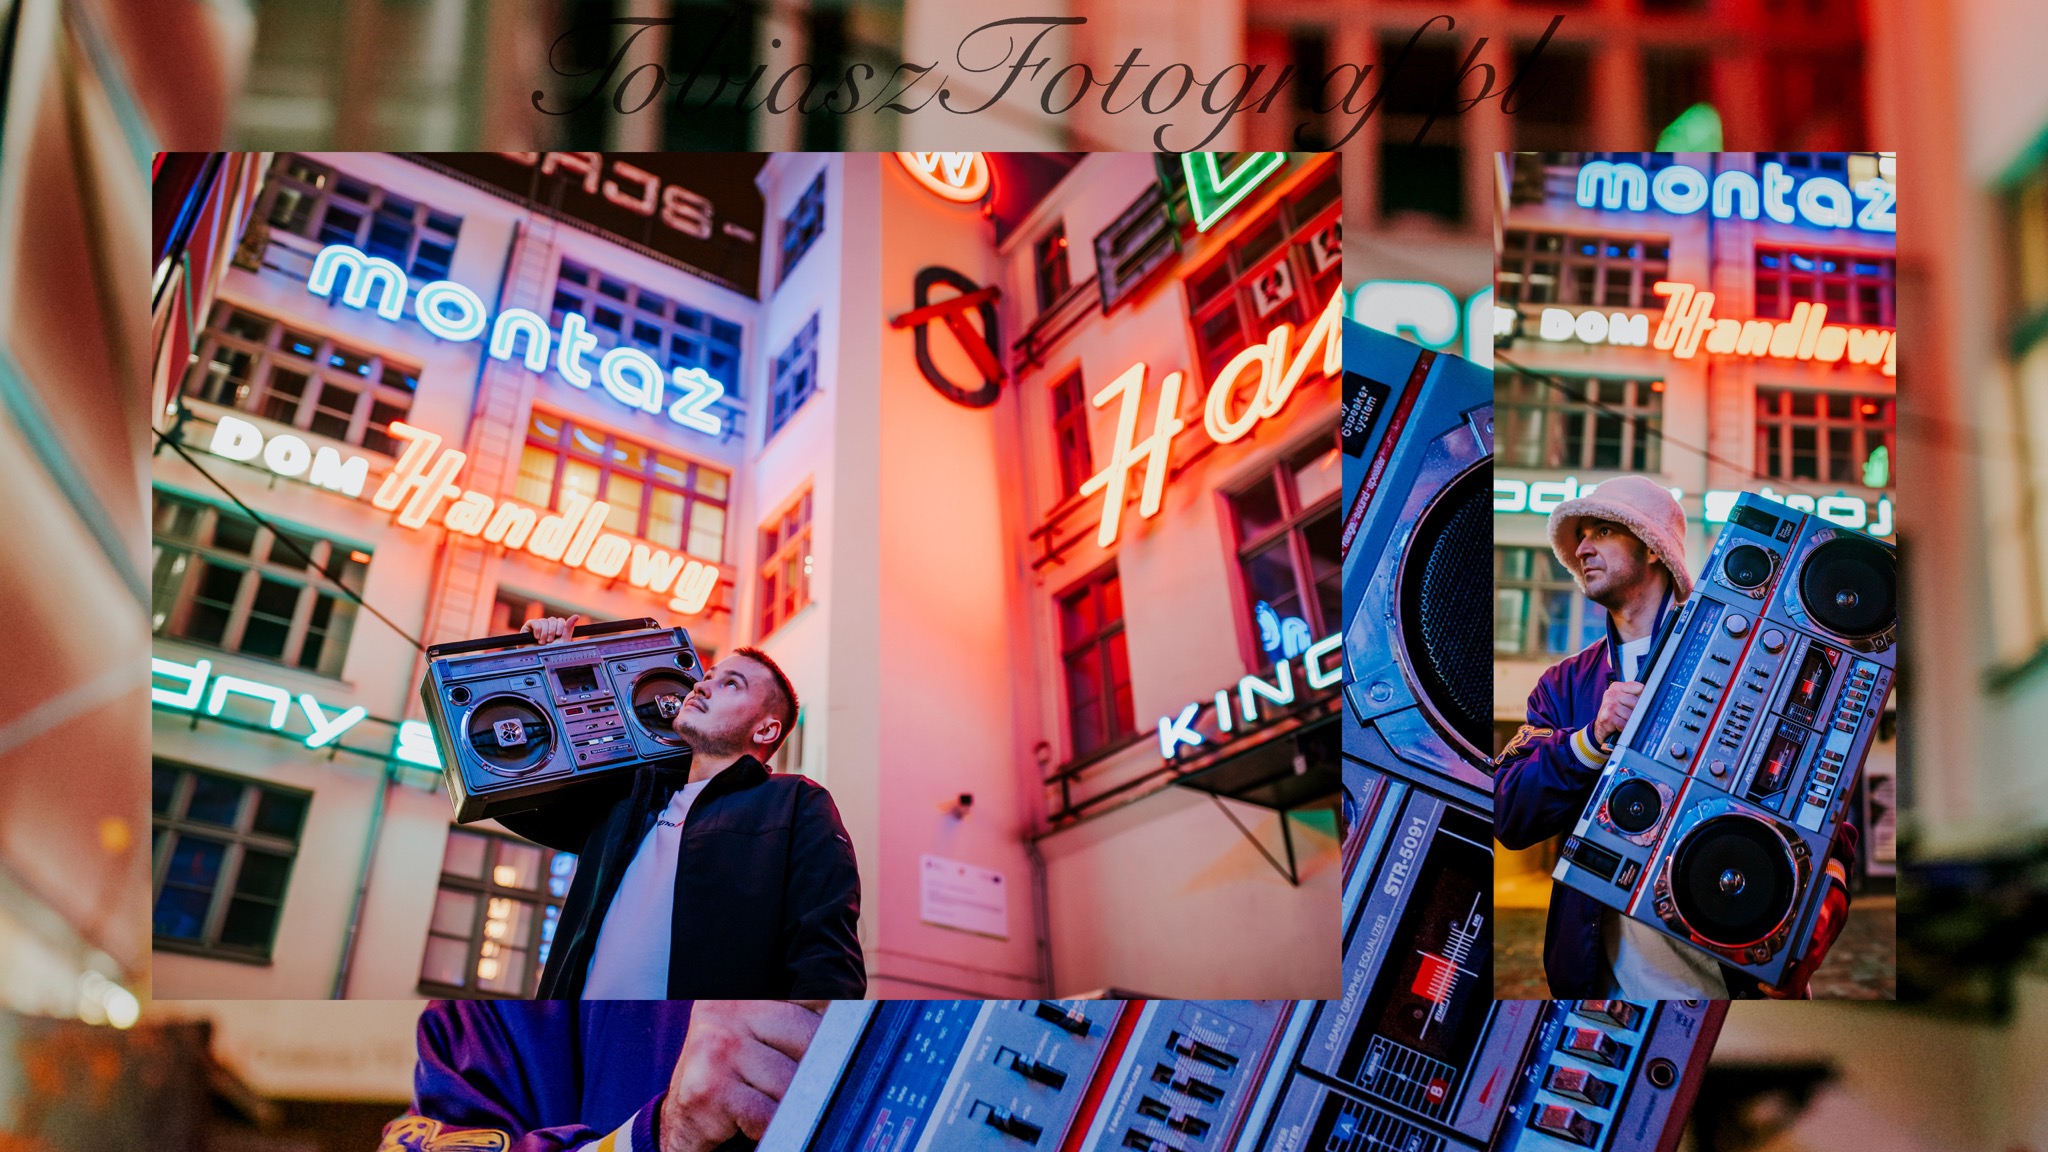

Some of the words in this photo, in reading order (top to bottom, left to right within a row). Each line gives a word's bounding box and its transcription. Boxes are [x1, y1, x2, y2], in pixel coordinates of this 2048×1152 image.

[1540, 308, 1650, 346] DOM
[1354, 394, 1378, 434] system
[208, 415, 370, 498] DOM
[372, 420, 719, 615] Handlowy
[1362, 777, 1372, 792] MAX
[1340, 967, 1365, 1014] GRAPHIC
[1358, 913, 1387, 969] EQUALIZER
[1383, 815, 1427, 898] STR-5091
[1529, 1064, 1541, 1083] PLAY
[1429, 1084, 1445, 1098] B
[1340, 1120, 1354, 1134] A
